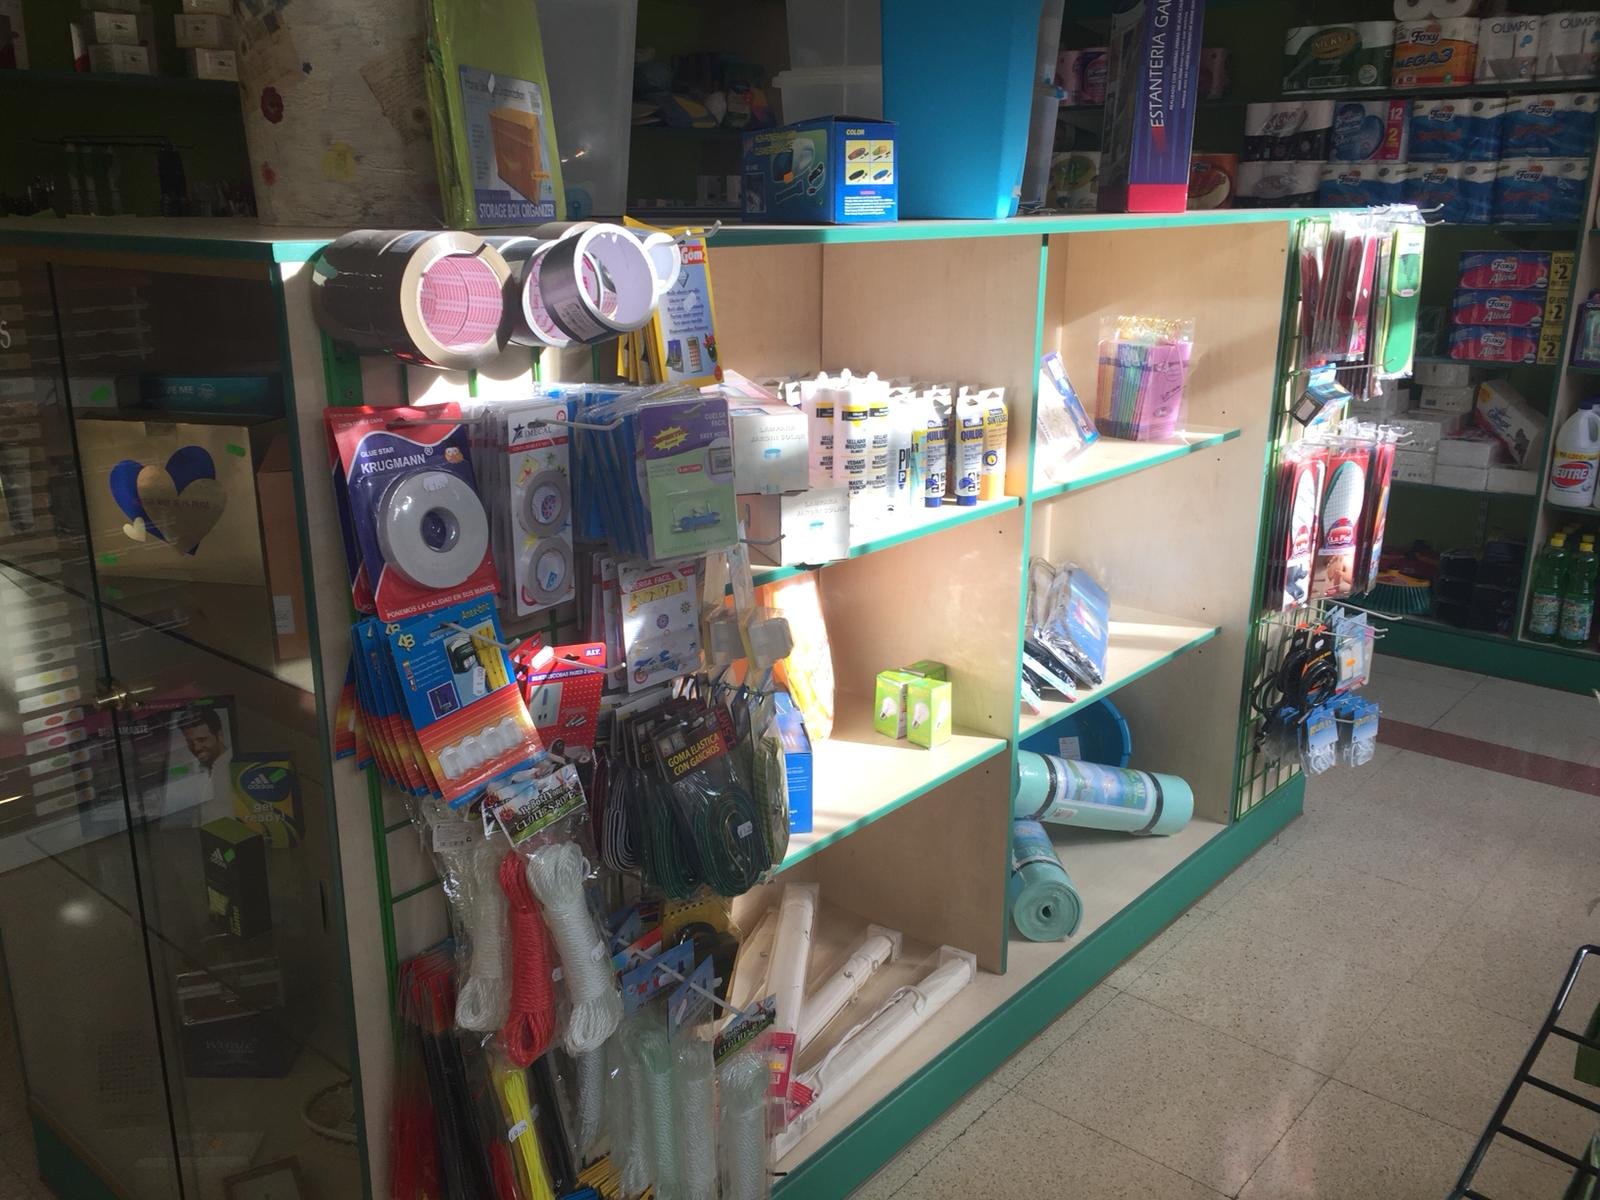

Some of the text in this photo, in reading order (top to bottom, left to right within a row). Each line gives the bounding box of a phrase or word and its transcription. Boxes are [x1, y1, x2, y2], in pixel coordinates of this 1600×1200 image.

[1411, 31, 1440, 44] Foxy
[1149, 33, 1166, 127] ESTANTERIA
[1390, 107, 1403, 120] 12
[1429, 109, 1454, 121] Foxy
[1388, 127, 1398, 140] 2
[1515, 170, 1542, 182] Foxy
[479, 203, 555, 219] STORAGE BOX ORGANIZER
[1493, 260, 1515, 271] Foxy
[1487, 299, 1510, 309] Foxy
[360, 453, 426, 475] KRUGMANN
[386, 606, 418, 619] PONEMOS
[418, 602, 427, 610] LA
[426, 597, 453, 608] CALIDAD
[667, 732, 721, 768] GOMA ELASTICA
[673, 743, 721, 776] CON GANCHOS
